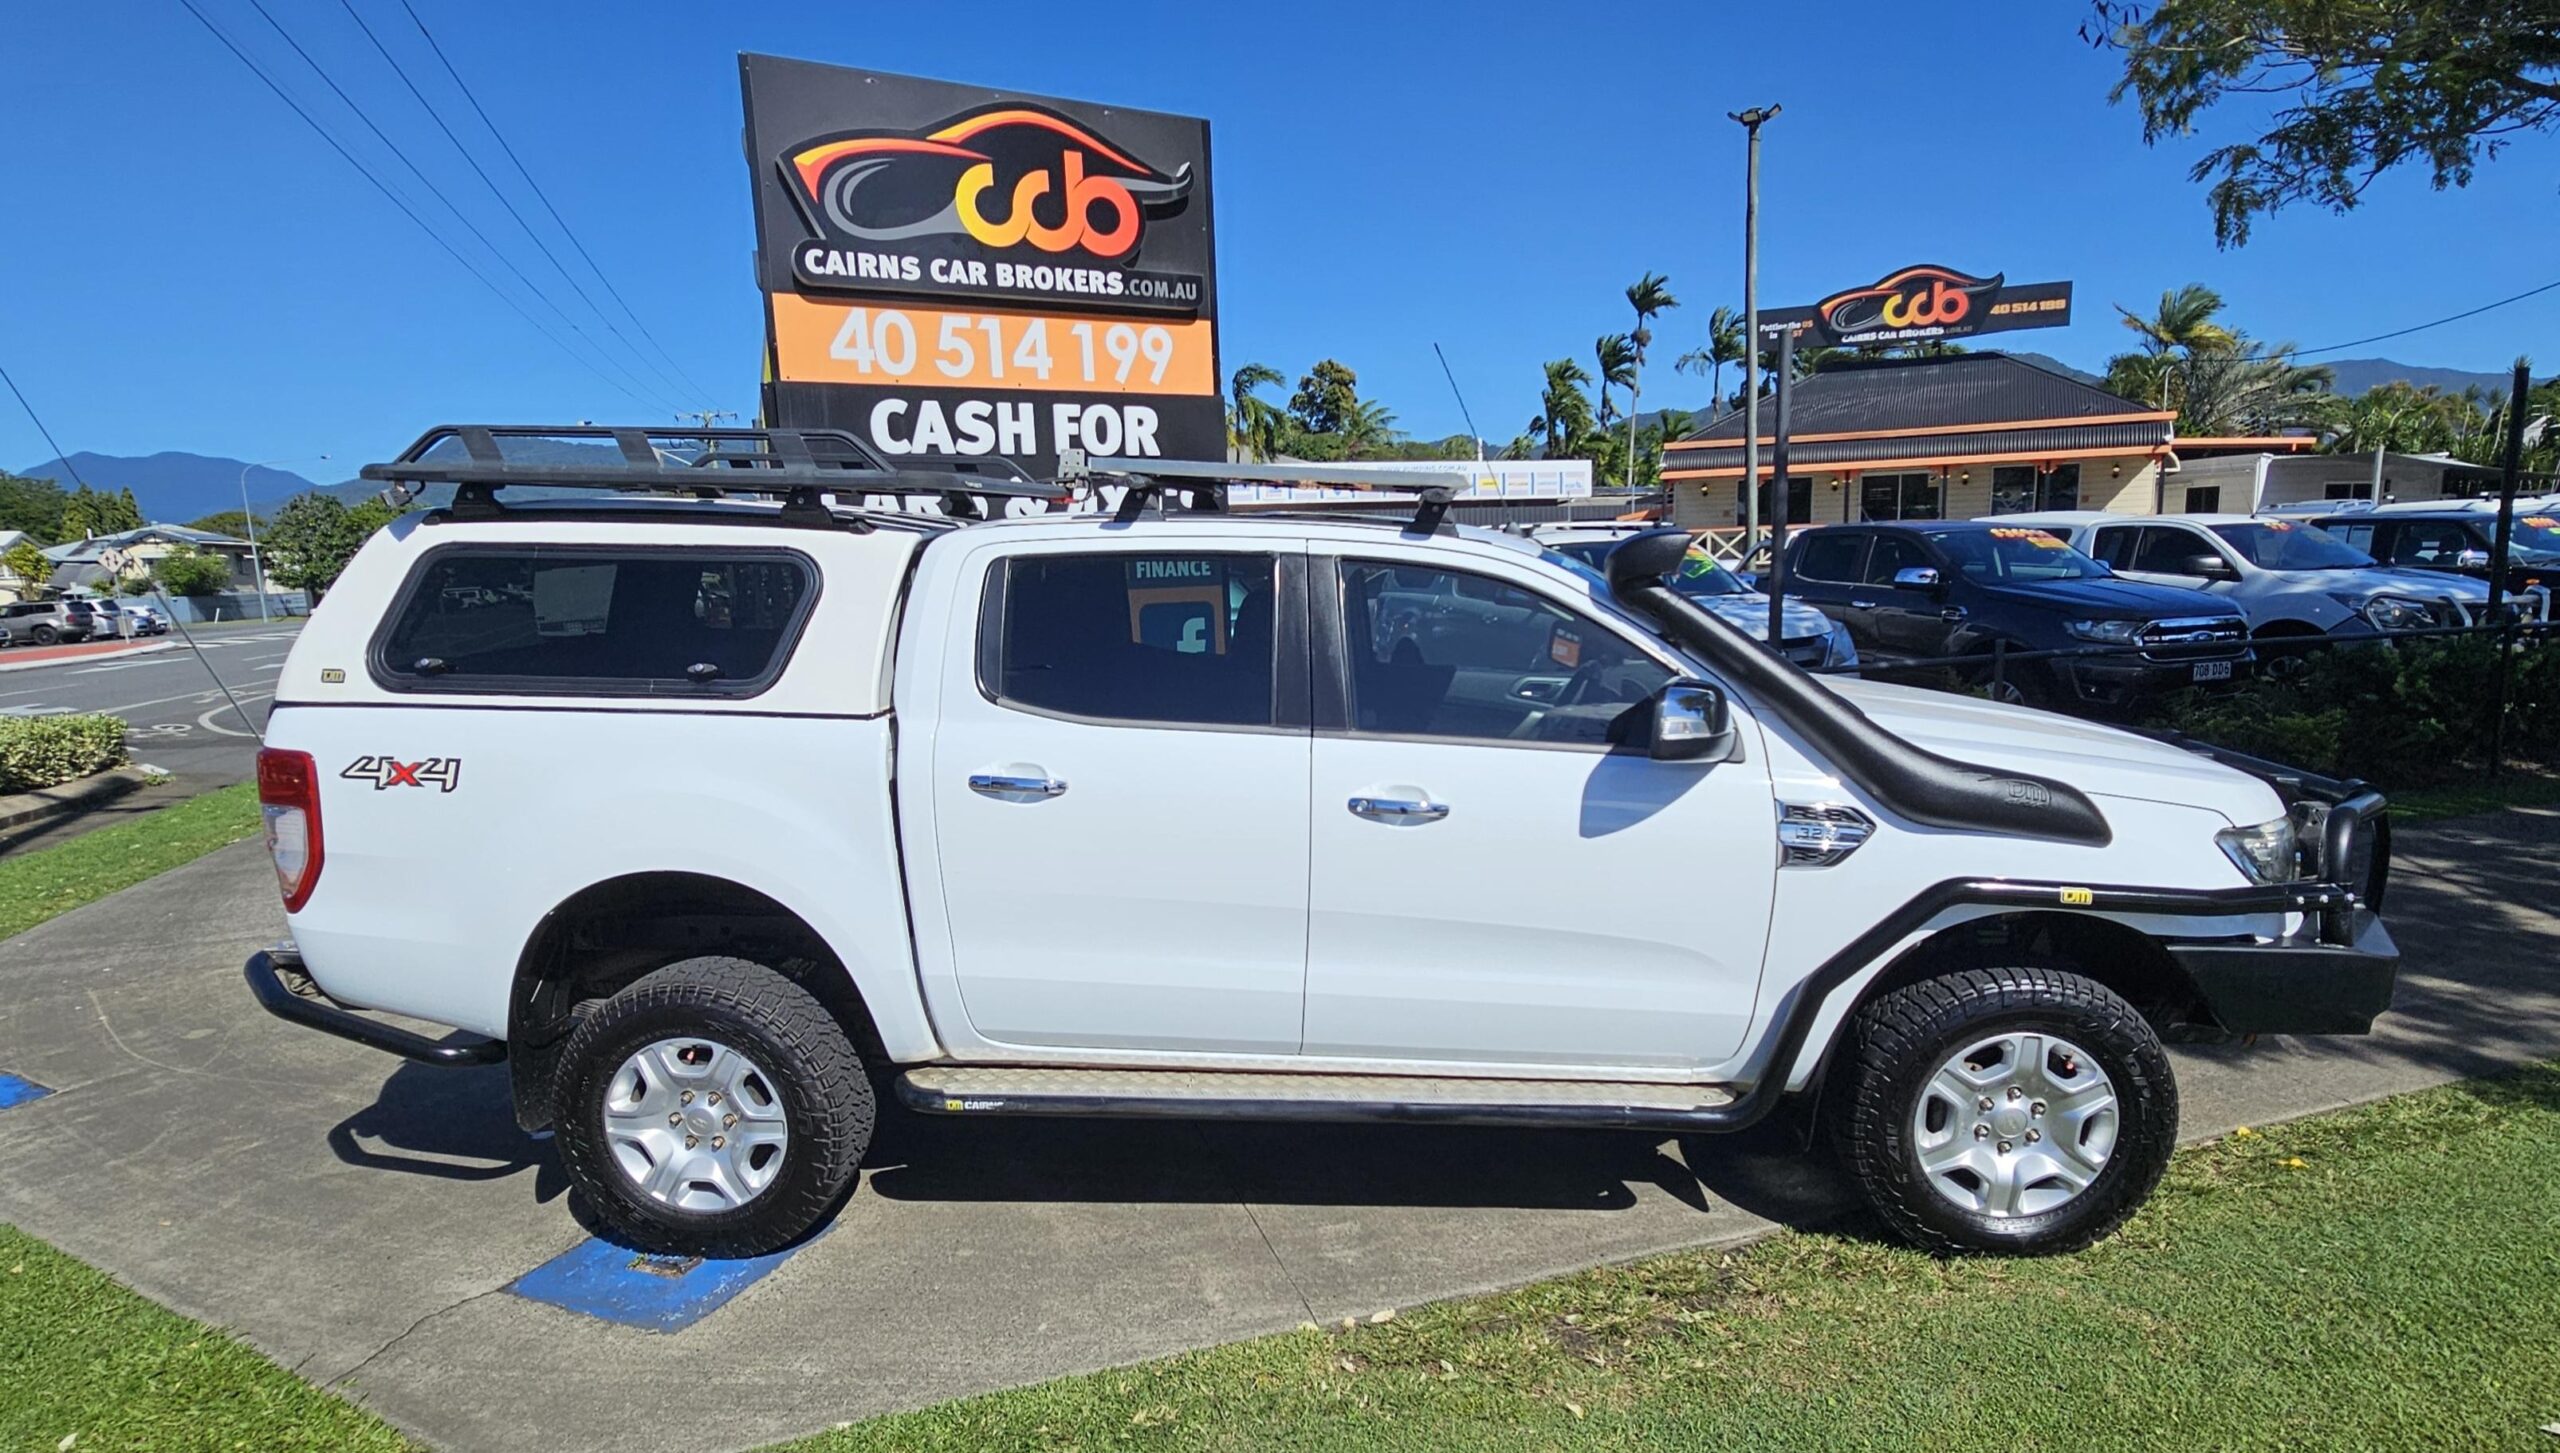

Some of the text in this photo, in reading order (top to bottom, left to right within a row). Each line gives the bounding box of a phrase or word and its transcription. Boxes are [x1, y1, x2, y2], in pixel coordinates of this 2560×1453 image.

[804, 247, 920, 283] CAIRNS
[930, 257, 988, 287] CAR
[1989, 303, 2010, 315] 40
[2011, 301, 2038, 313] 514
[829, 306, 1174, 386] 40 514 199
[1878, 329, 1898, 340] CAR
[869, 398, 1163, 458] CASH FOR
[1136, 560, 1212, 578] FINANCE
